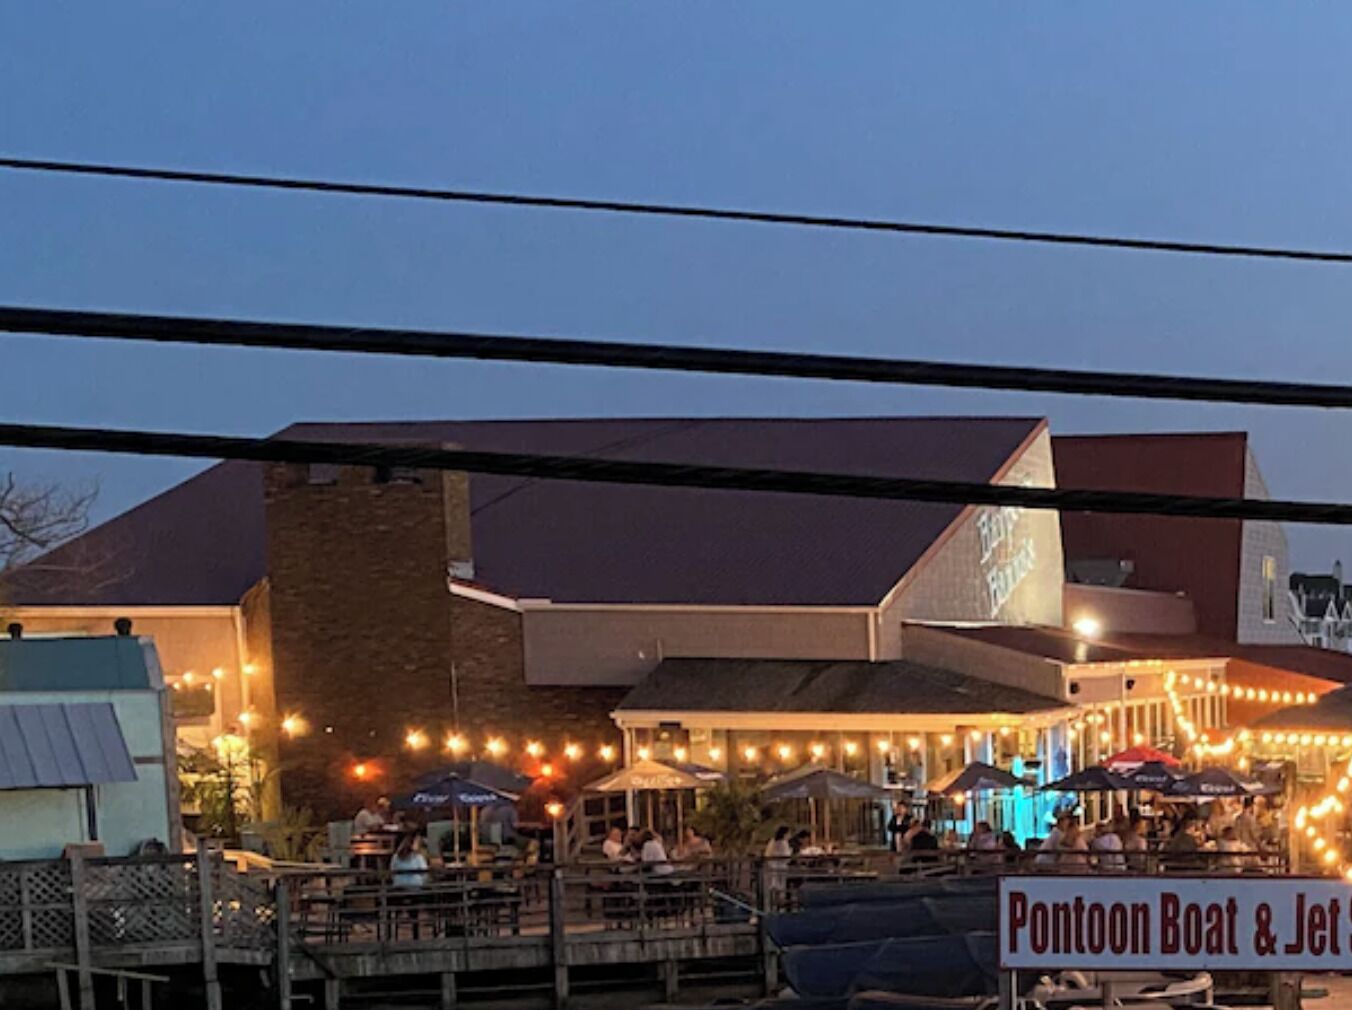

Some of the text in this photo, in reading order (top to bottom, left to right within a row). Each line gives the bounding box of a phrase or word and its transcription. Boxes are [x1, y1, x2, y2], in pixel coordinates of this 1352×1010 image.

[1008, 890, 1151, 956] Pontoon
[1160, 892, 1239, 957] Boat
[1253, 902, 1277, 957] &
[1284, 892, 1341, 957] Jet
